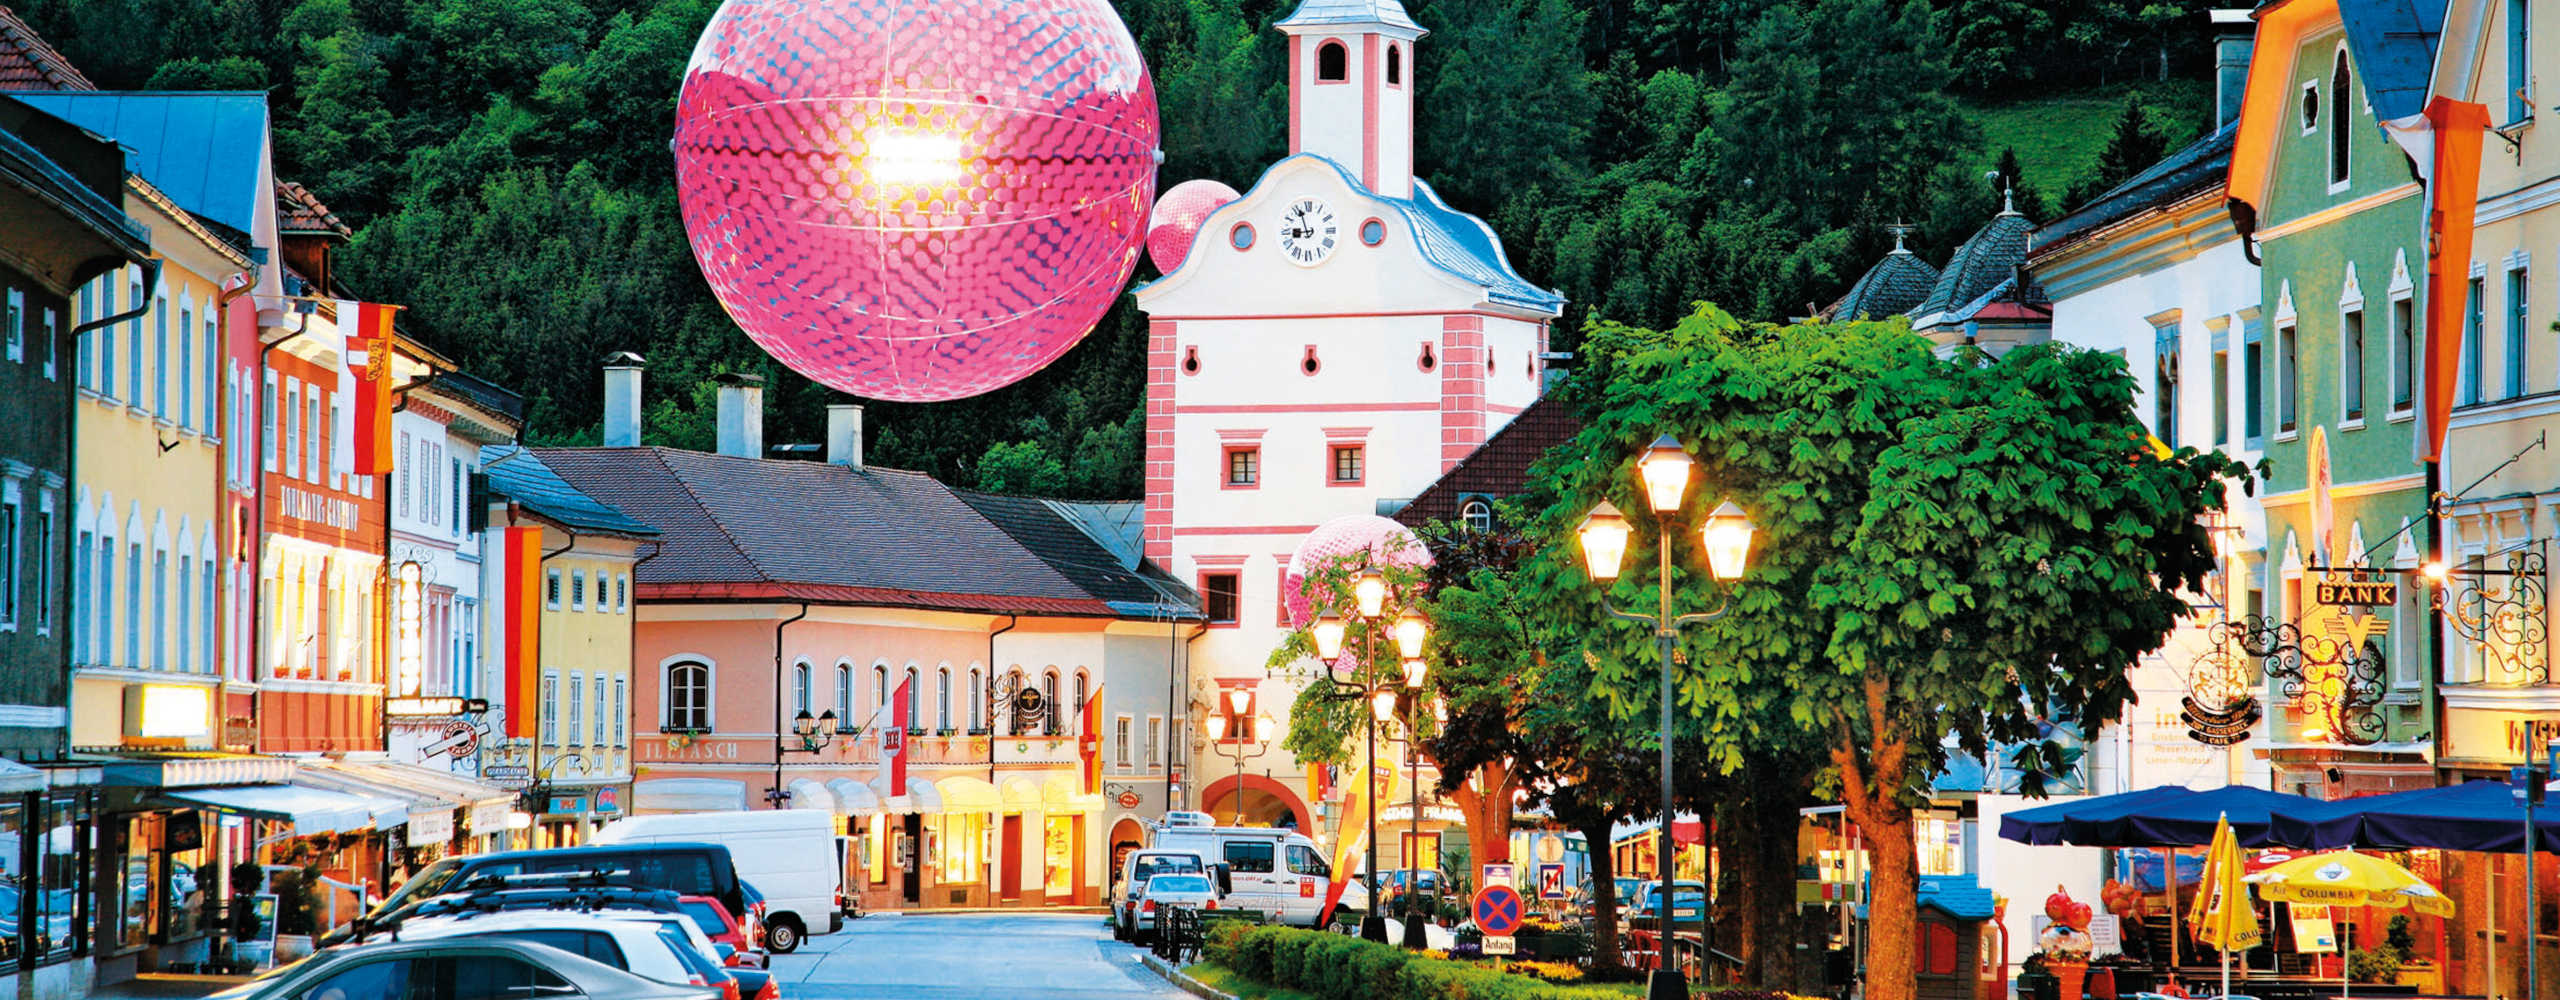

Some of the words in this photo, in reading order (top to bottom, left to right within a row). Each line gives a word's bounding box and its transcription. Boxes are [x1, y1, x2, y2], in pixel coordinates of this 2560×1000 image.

[2320, 587, 2392, 604] BANK
[2300, 887, 2354, 899] COLUMBIA
[1485, 937, 1513, 953] Anfang
